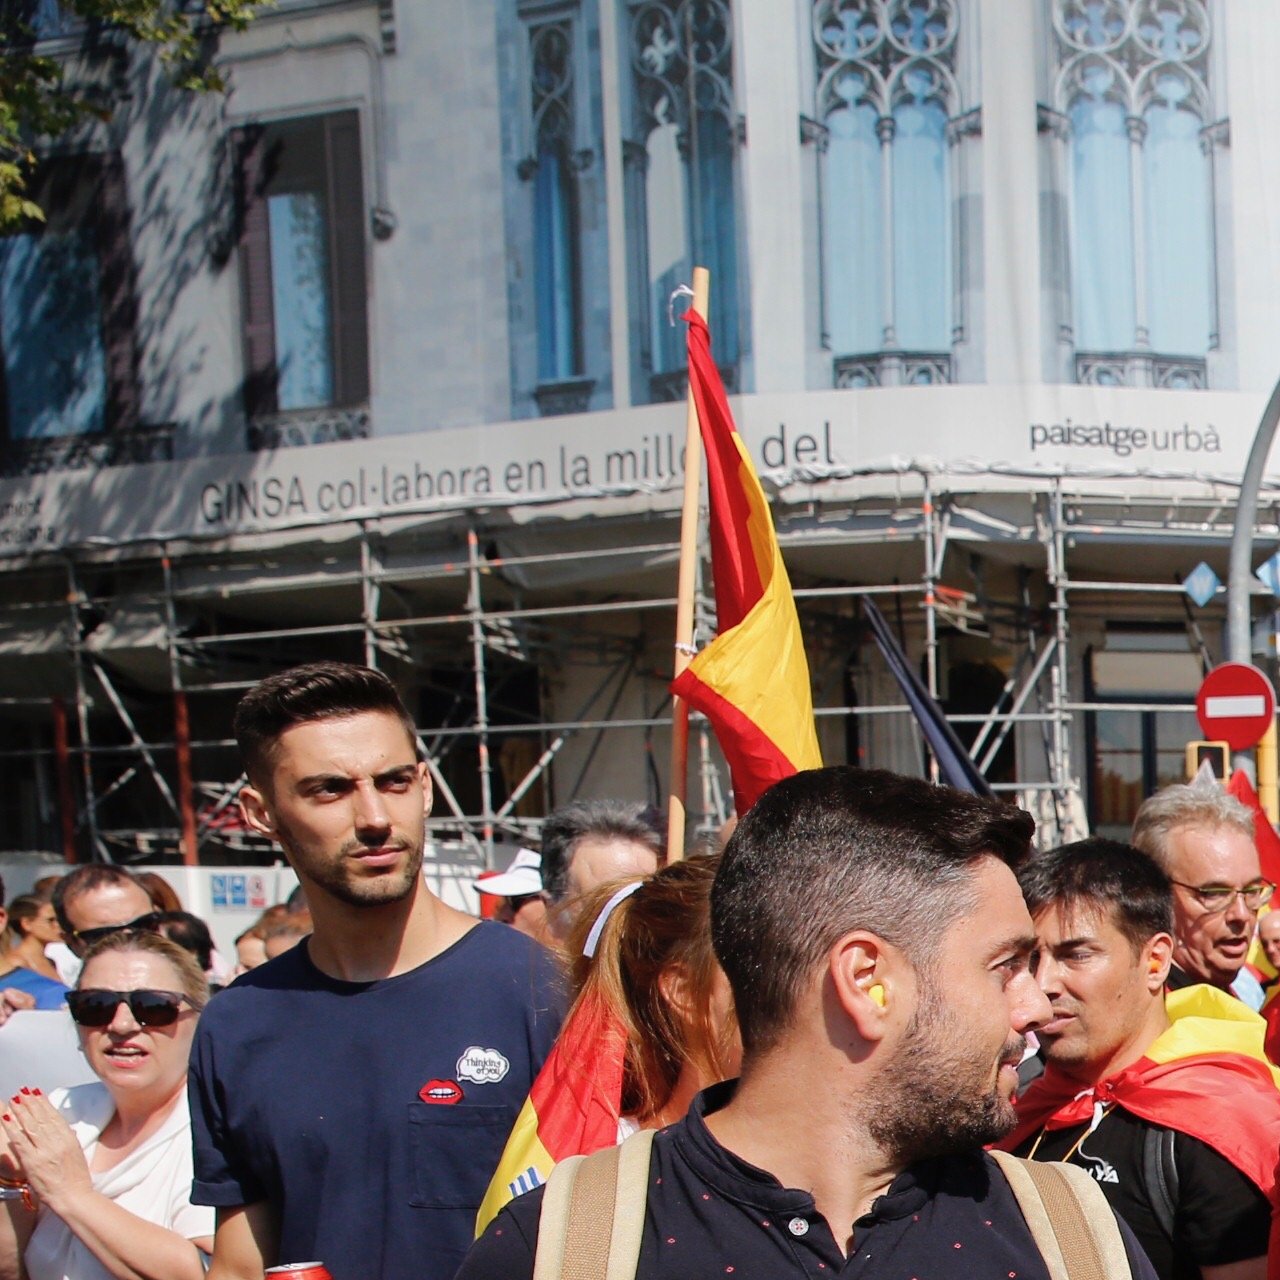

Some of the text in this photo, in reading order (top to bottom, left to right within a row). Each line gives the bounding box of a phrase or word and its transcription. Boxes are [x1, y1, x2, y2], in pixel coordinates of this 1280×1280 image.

[201, 421, 835, 524] GINSA col·labora en la mill del
[465, 1057, 501, 1069] Thinking
